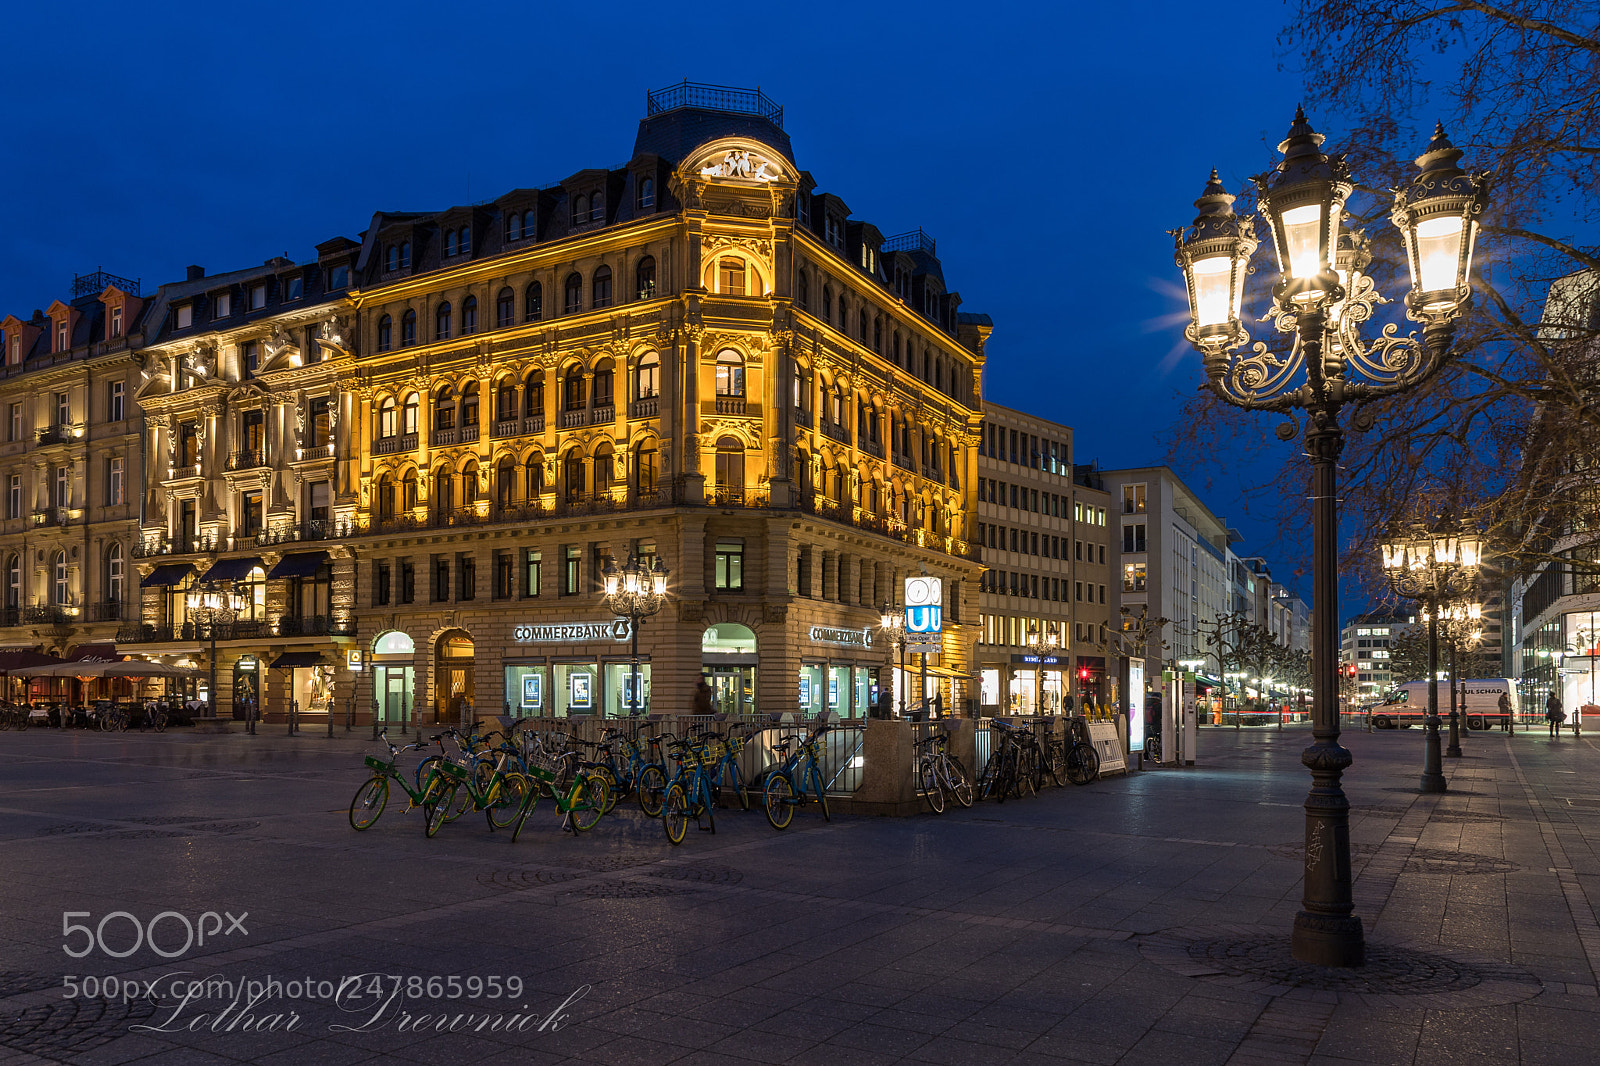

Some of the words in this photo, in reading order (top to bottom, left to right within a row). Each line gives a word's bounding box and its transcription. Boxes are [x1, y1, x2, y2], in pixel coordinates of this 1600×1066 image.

[907, 608, 929, 632] U
[931, 608, 941, 632] U
[514, 624, 609, 641] COMMERZBANK
